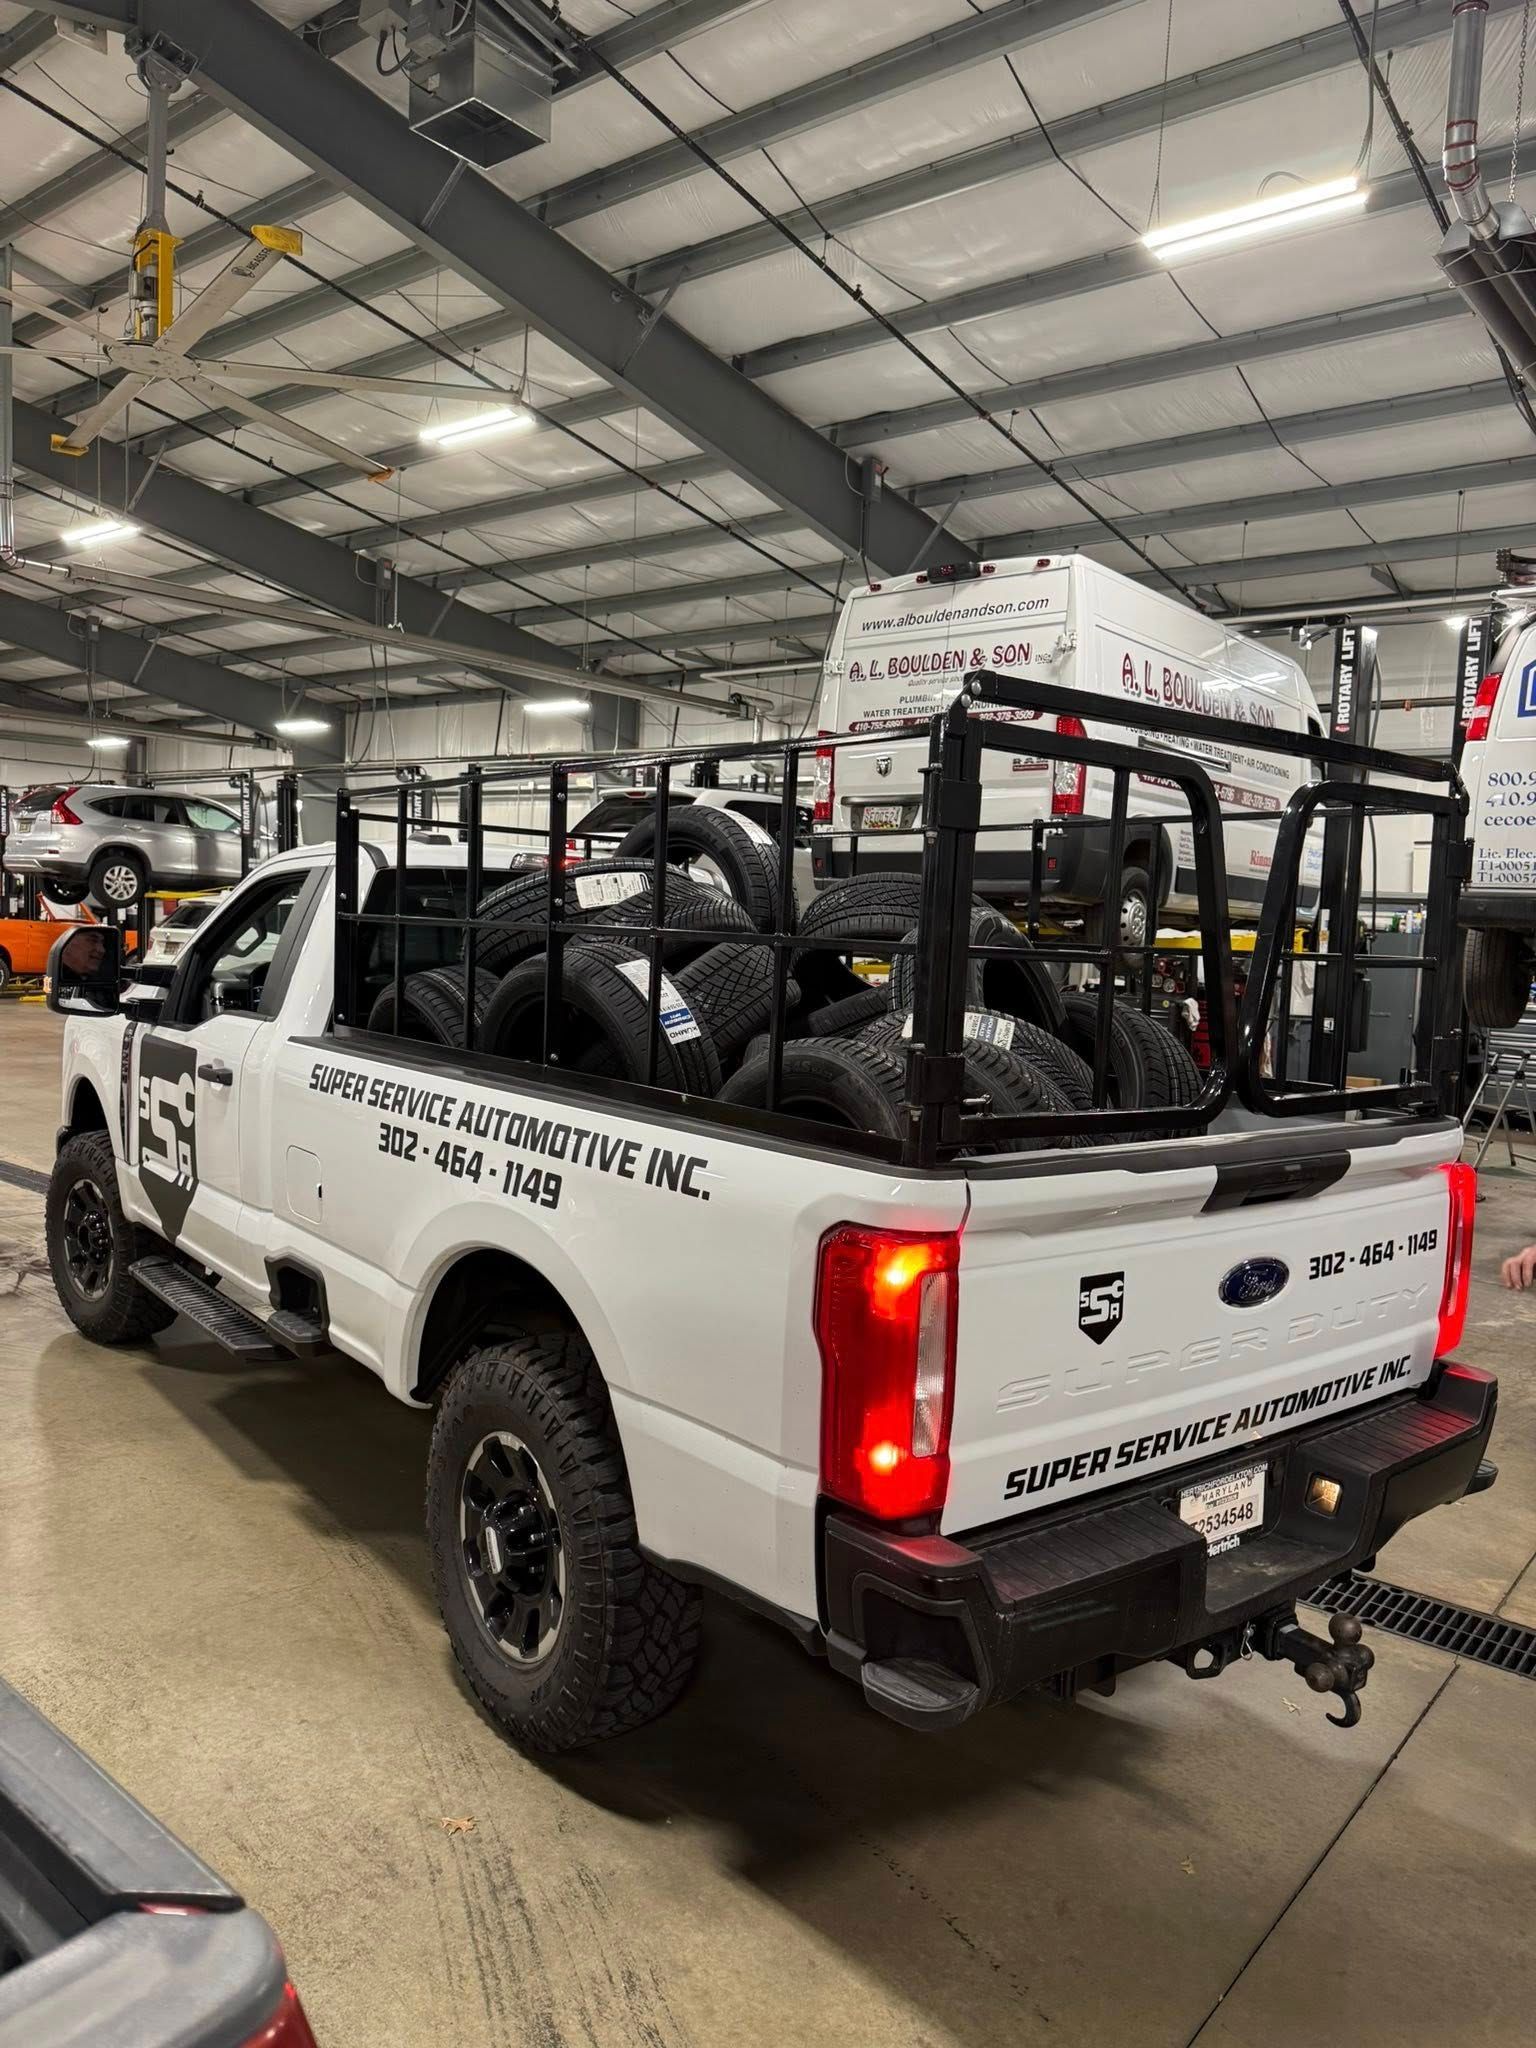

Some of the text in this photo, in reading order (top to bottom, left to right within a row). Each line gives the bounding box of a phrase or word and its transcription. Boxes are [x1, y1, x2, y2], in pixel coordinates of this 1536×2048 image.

[862, 598, 1049, 631] www.albouldenandson.com
[849, 661, 866, 681] A.
[869, 659, 884, 679] L.
[887, 649, 965, 676] BOULDEN
[969, 647, 987, 669] &
[992, 642, 1031, 666] SON
[1122, 652, 1141, 694] A.
[1144, 660, 1160, 702] L.
[1162, 667, 1231, 719] BOULDEN
[1250, 701, 1275, 730] SON
[1336, 628, 1355, 725] ROTARY LIFT
[1461, 618, 1482, 719] ROTARY LIFT
[863, 708, 890, 718] WATER
[893, 704, 940, 716] TREATMENT
[1194, 739, 1213, 755] WATER
[1256, 760, 1290, 779] CONDITIONING
[1479, 847, 1502, 859] Lic.
[309, 1063, 711, 1201] SUPER SERVICE AUTOMOTIVE INC.
[996, 1282, 1429, 1414] SUPER DUTY
[1003, 1354, 1412, 1500] SUPER SERVICE AUTOMOTIVE INC.
[1202, 1479, 1253, 1503] MARYLAND
